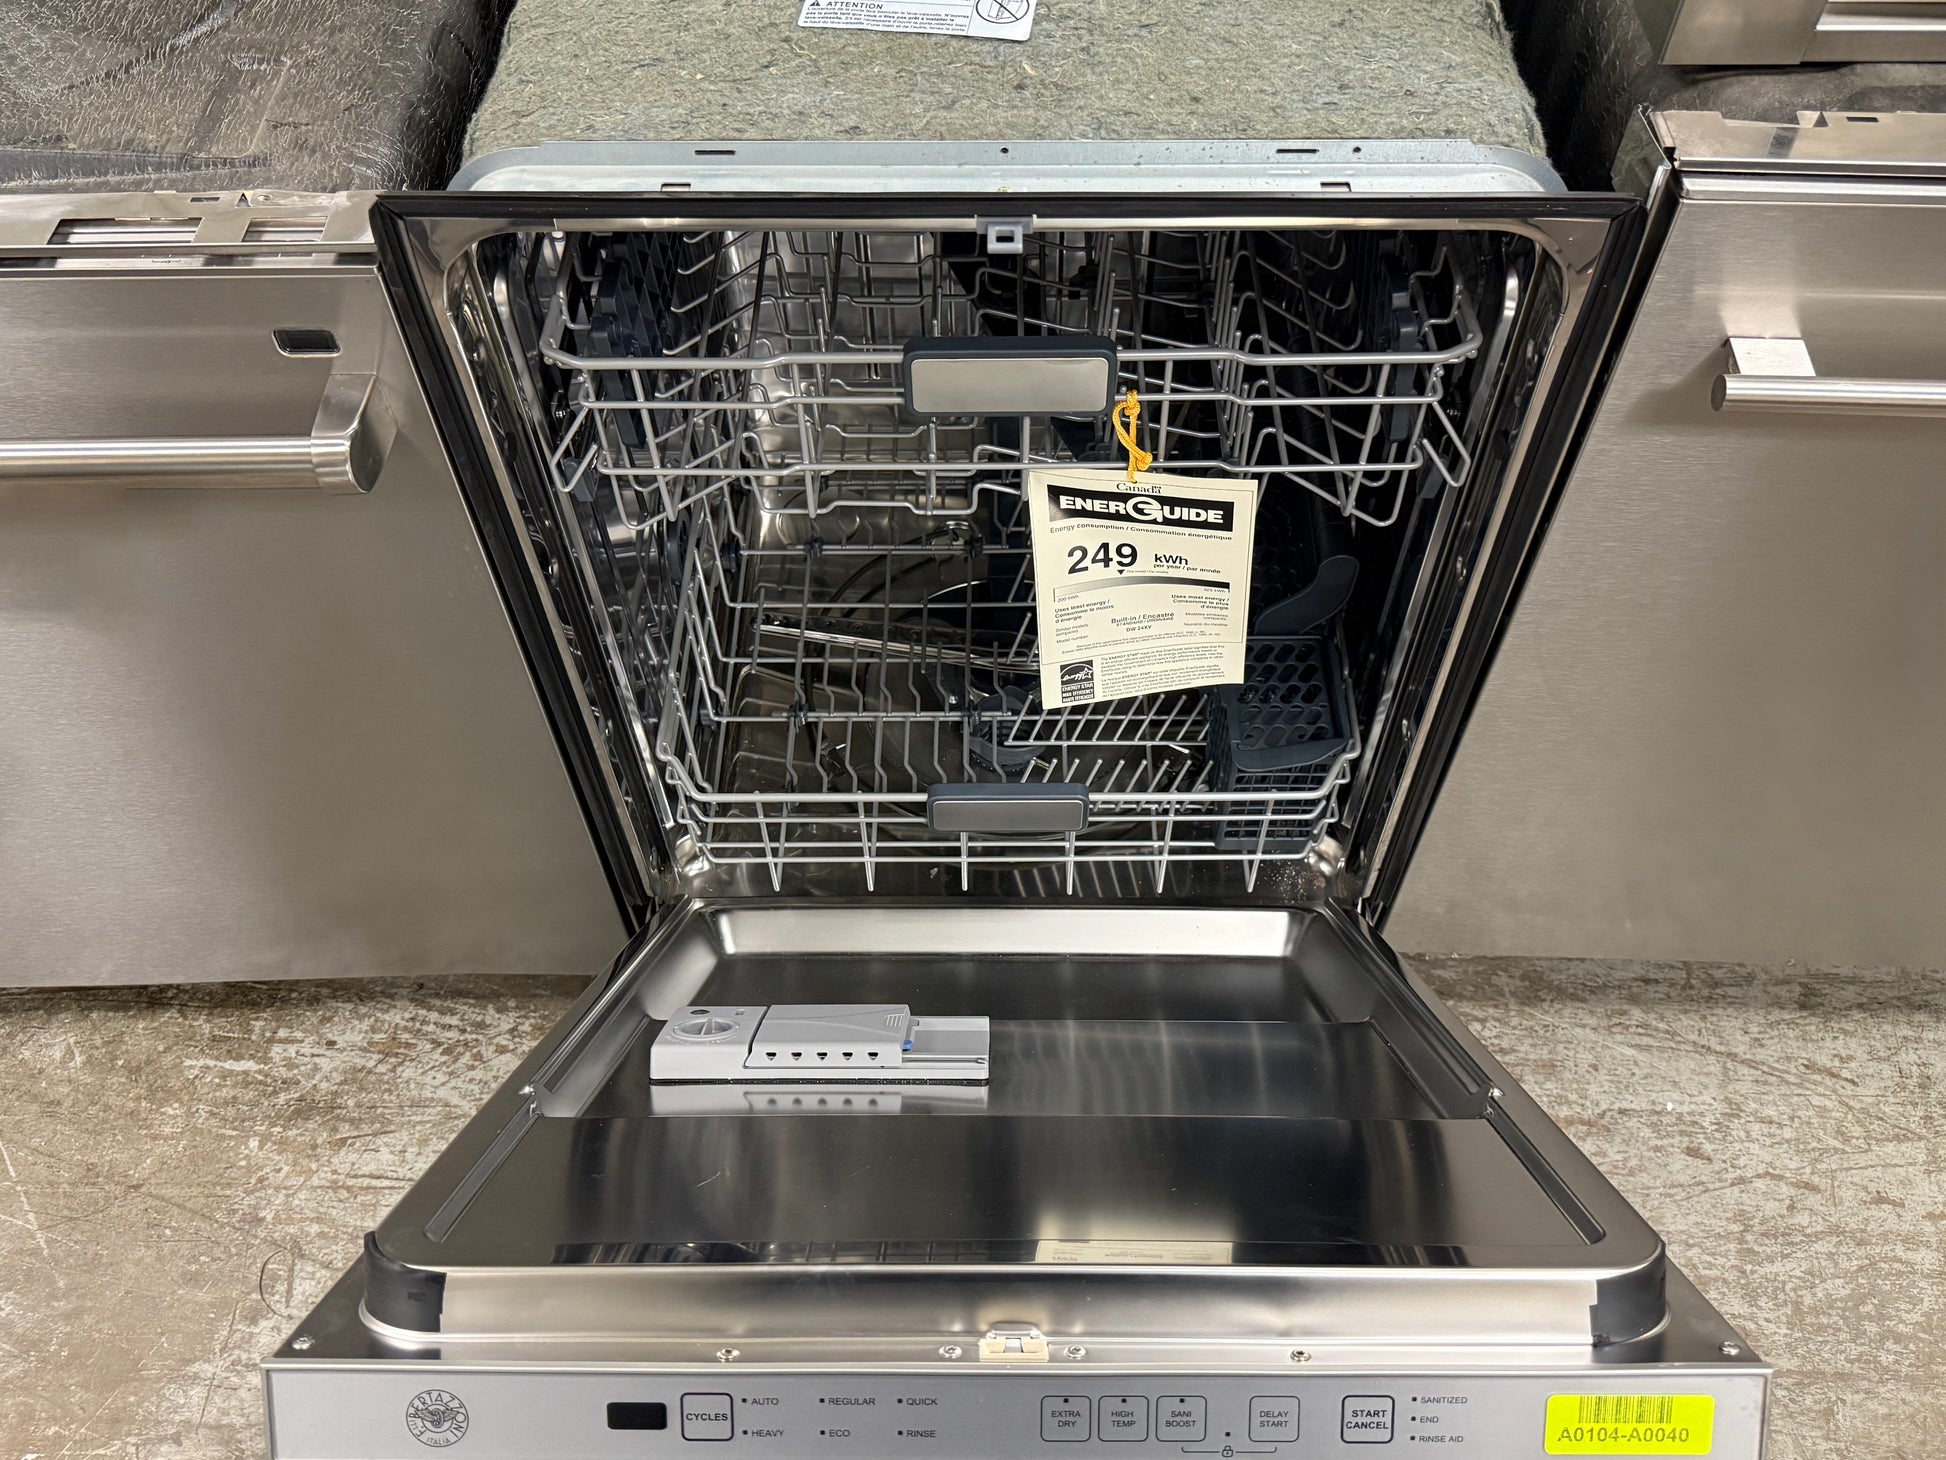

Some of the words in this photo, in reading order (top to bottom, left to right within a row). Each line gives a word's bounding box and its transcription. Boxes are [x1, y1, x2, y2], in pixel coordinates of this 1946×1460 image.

[826, 2, 884, 10] ATTENTION
[1116, 482, 1162, 494] Canada
[1059, 495, 1224, 524] ENERGUIDE
[1050, 524, 1075, 534] Energy
[1130, 526, 1186, 536] Consommation
[1188, 532, 1232, 541] énergétique
[1067, 542, 1138, 574] 249
[1154, 553, 1189, 565] kWh
[1111, 615, 1137, 624] Built-in
[1142, 612, 1175, 620] Encastré
[1062, 683, 1081, 692] ENERGY
[906, 1398, 938, 1406] QUICK
[686, 1412, 728, 1421] CYCLES
[1351, 1410, 1387, 1418] START
[1345, 1421, 1389, 1429] CANCEL
[1557, 1427, 1690, 1442] A0104-A0040
[426, 1437, 451, 1445] ITALIA
